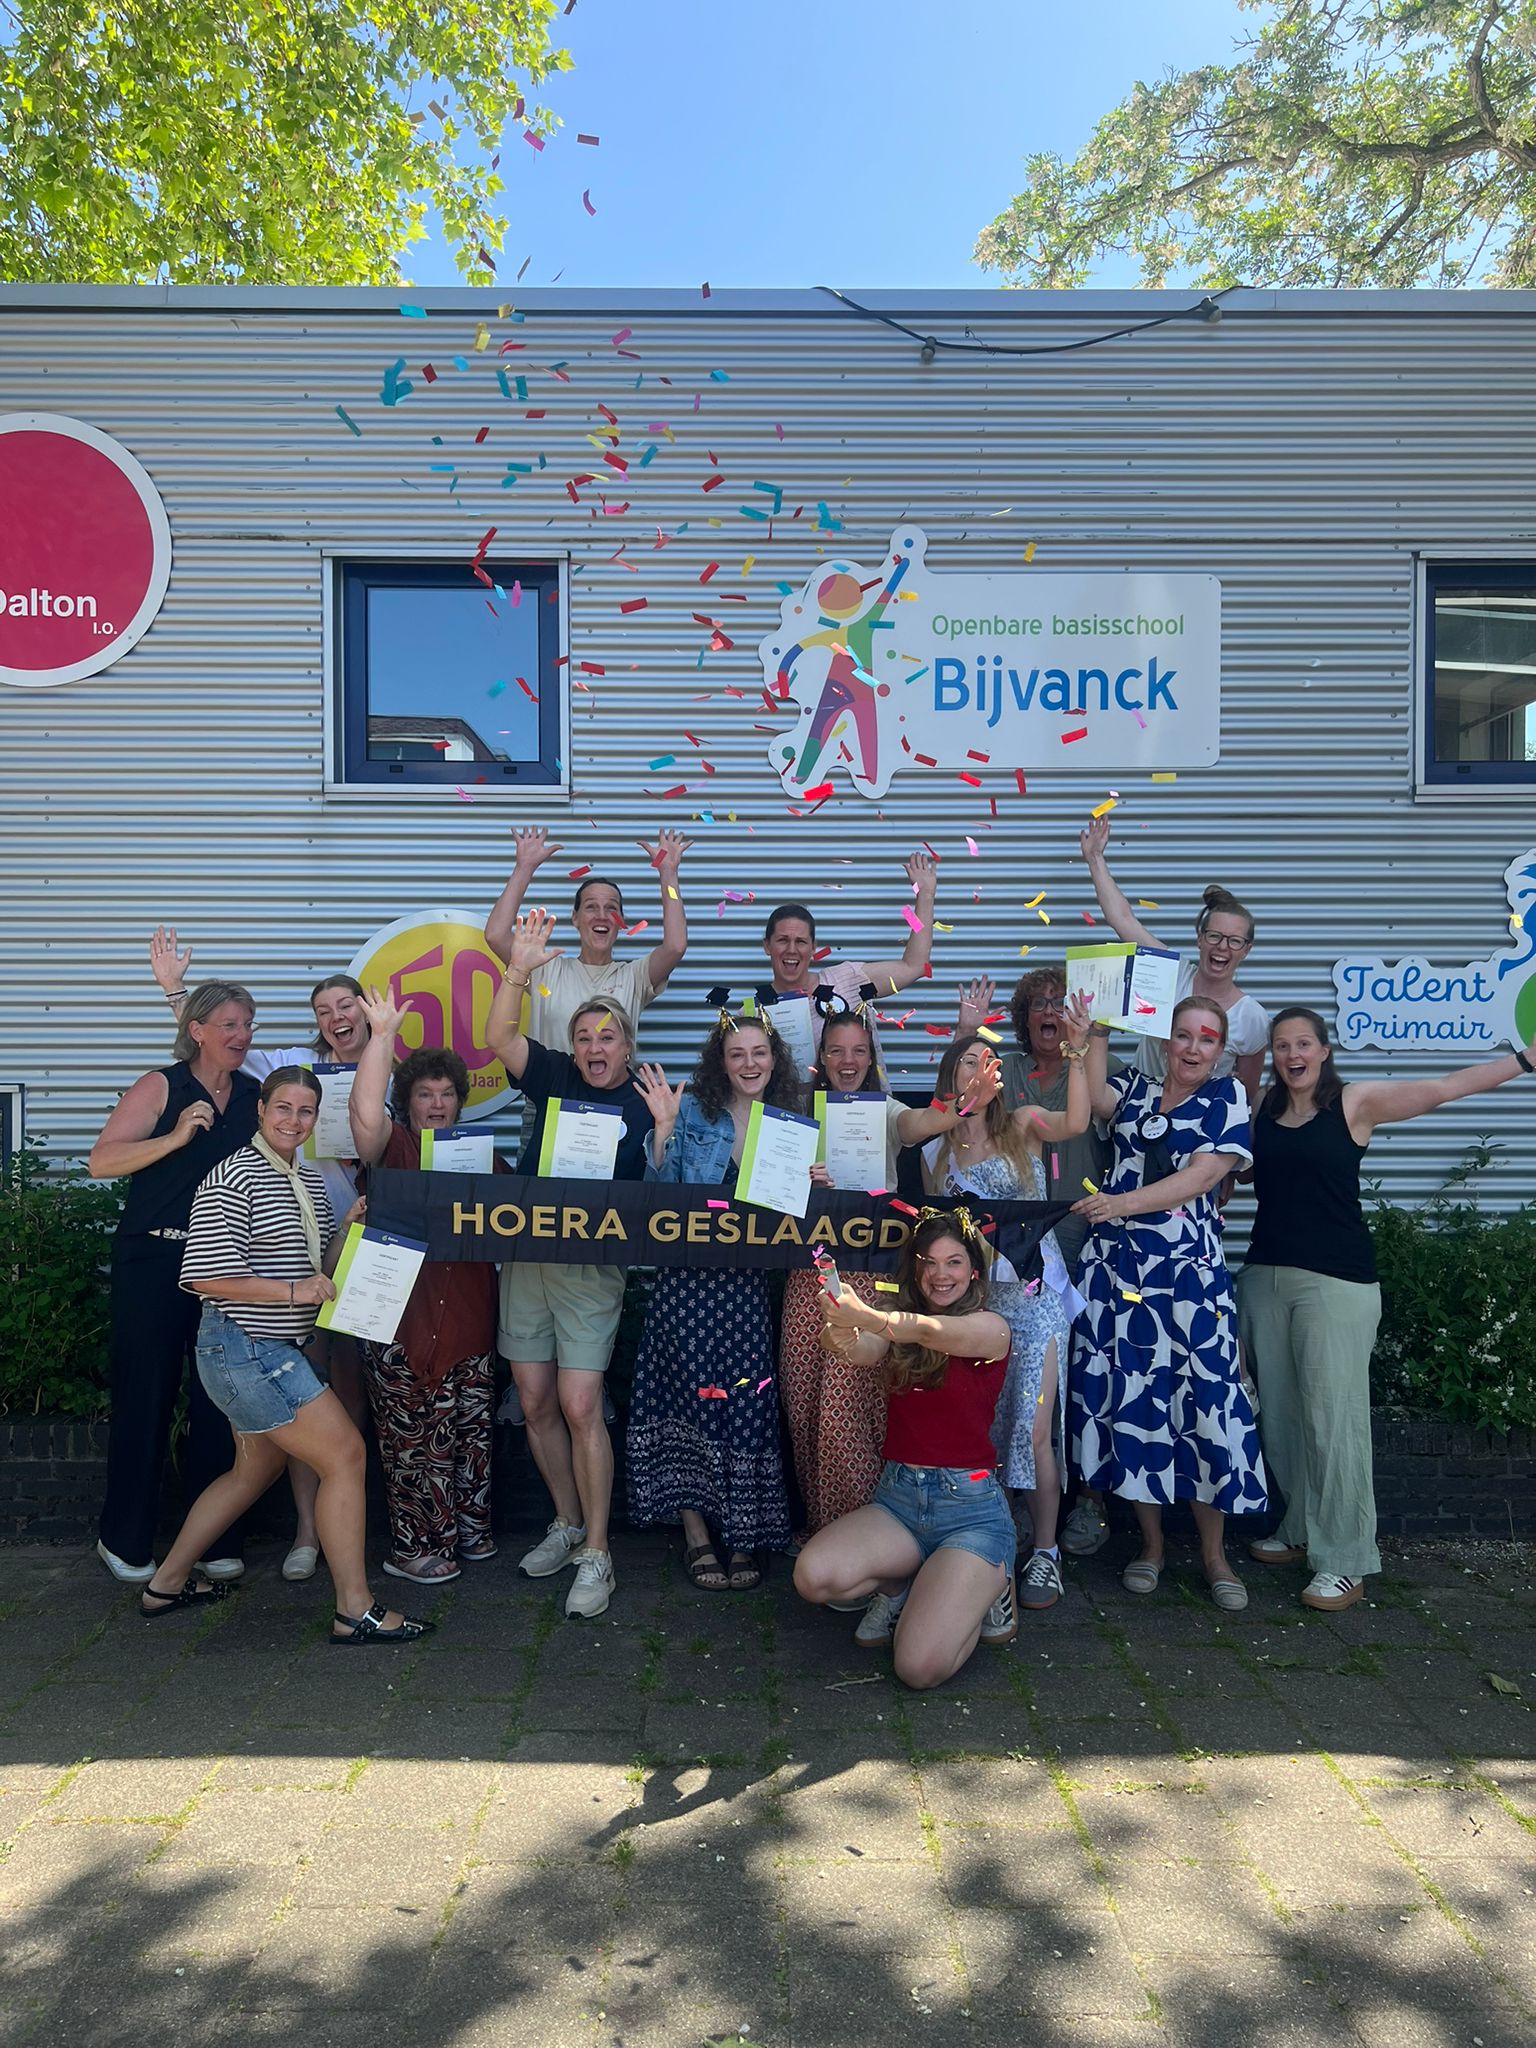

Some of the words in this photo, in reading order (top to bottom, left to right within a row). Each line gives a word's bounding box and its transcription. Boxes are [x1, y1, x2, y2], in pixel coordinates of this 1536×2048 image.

[0, 587, 97, 617] alton
[93, 622, 118, 635] I.O.
[931, 614, 1043, 641] Openbare
[1051, 614, 1185, 636] basisschool
[934, 655, 1179, 728] Bijvanck
[1343, 964, 1496, 1003] Talent
[389, 943, 504, 1071] 50
[1346, 1011, 1493, 1041] Primair
[470, 1073, 503, 1088] Jaar
[453, 1202, 628, 1241] HOERA
[648, 1209, 910, 1249] GESLAAGD
